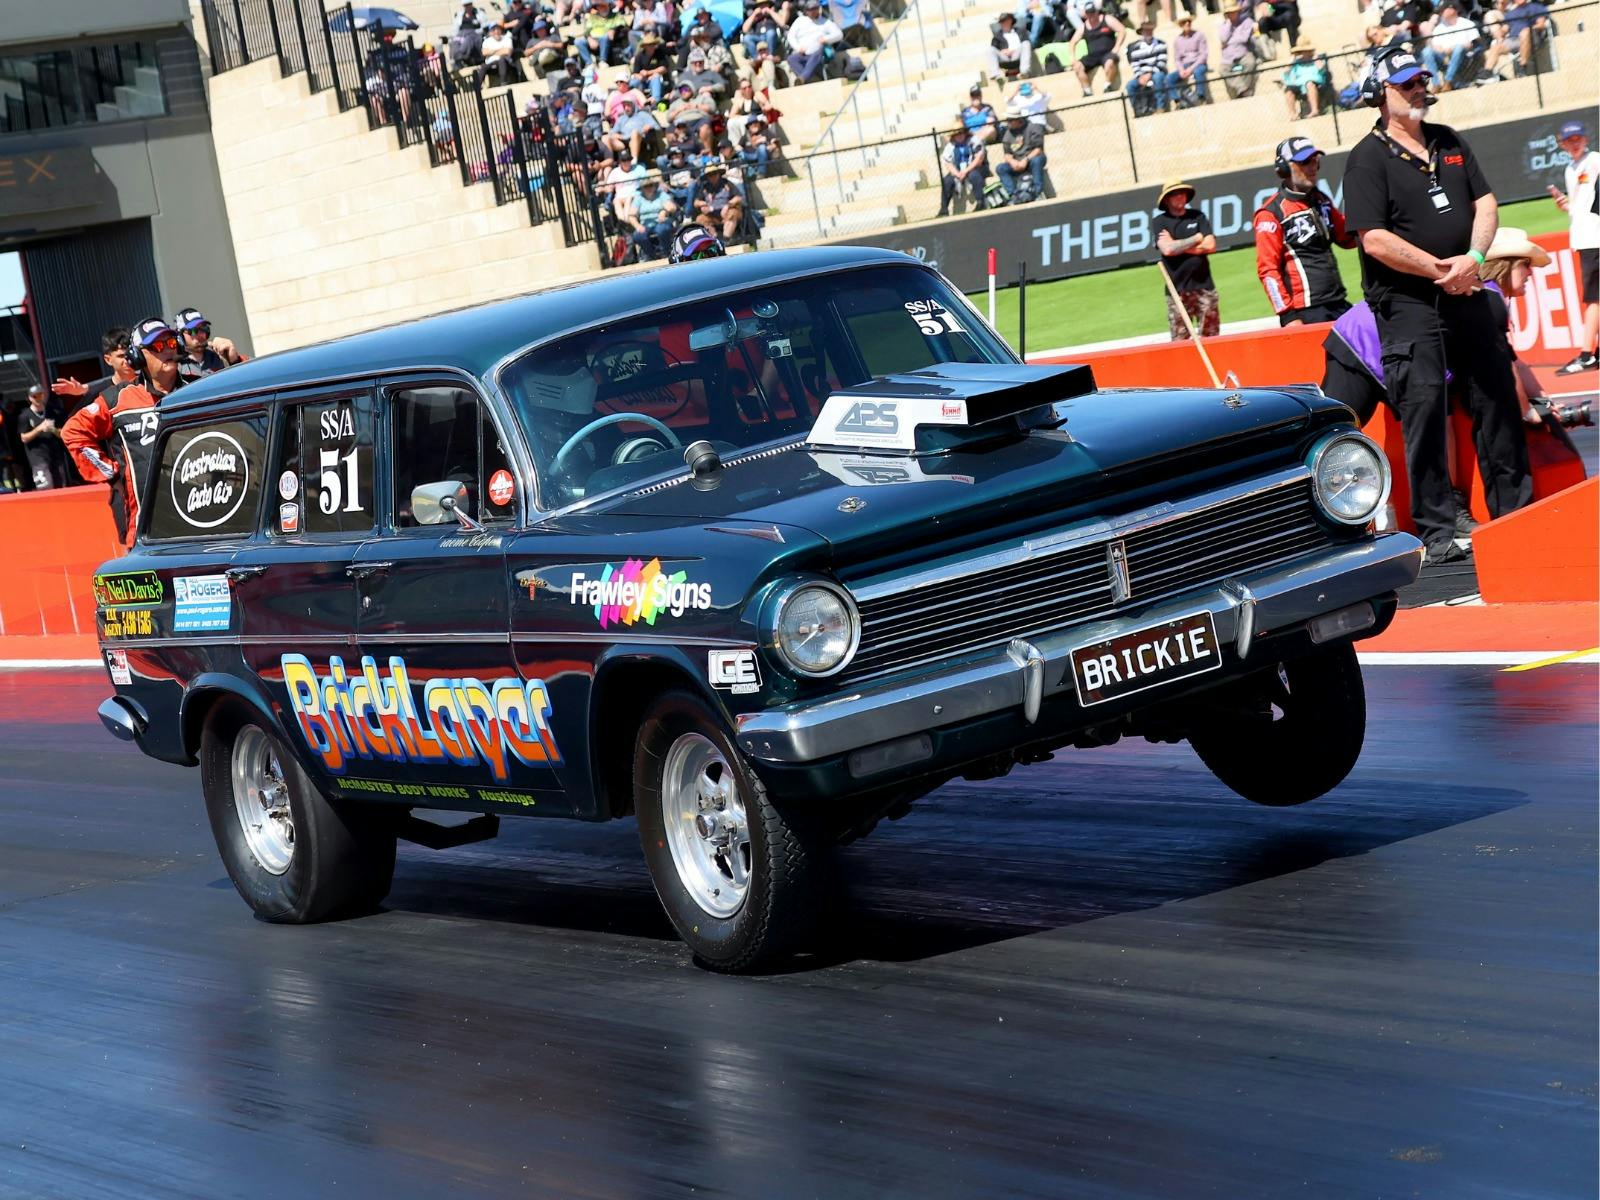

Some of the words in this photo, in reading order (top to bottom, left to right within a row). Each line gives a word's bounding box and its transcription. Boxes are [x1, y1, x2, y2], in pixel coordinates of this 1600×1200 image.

[904, 299, 943, 313] SS/A
[911, 309, 967, 336] 51
[320, 408, 355, 440] SS/A
[835, 402, 899, 434] APS
[181, 446, 236, 484] Australian
[320, 447, 364, 515] 51
[187, 482, 212, 513] Auto
[213, 481, 232, 504] Air
[106, 578, 126, 601] Neil
[126, 577, 156, 600] Davis
[190, 583, 229, 596] ROGERS
[571, 572, 646, 616] Frawley
[652, 573, 711, 617] Signs
[1082, 626, 1211, 691] BRICKIE
[336, 778, 396, 794] McMASTER
[396, 784, 427, 796] BODY
[427, 786, 470, 799] WORKS
[477, 789, 536, 806] Hastings
